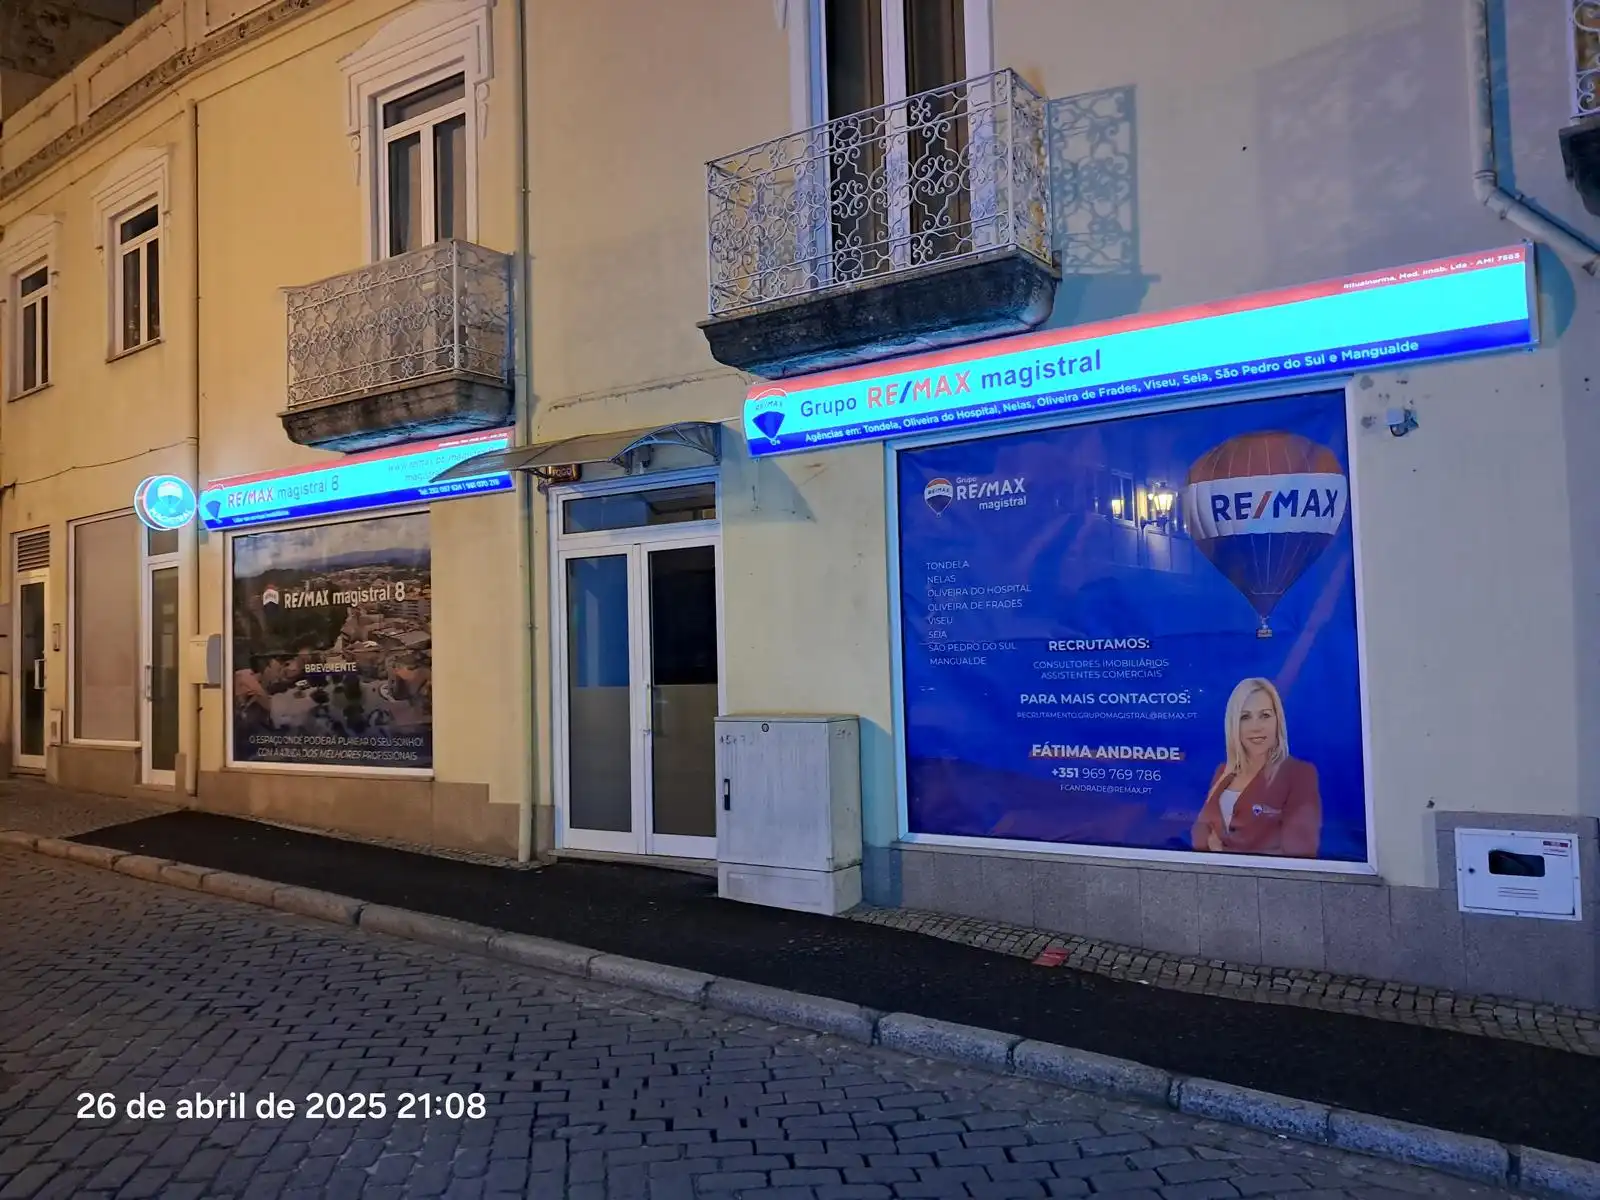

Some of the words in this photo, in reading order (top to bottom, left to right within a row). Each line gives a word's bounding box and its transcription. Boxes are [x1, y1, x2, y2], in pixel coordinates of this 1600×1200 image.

[1475, 257, 1494, 266] AMI
[800, 397, 857, 417] Grupo
[867, 370, 971, 409] RE/MAX
[981, 349, 1101, 389] magistral
[805, 428, 843, 443] Agências
[845, 427, 862, 436] em:
[863, 420, 902, 434] Tondela,
[903, 415, 940, 427] Oliveira
[941, 412, 955, 422] do
[956, 407, 1001, 420] Hospital,
[1003, 401, 1035, 413] Nelas,
[1037, 392, 1079, 407] Oliveira
[1082, 389, 1096, 401] de
[1098, 383, 1142, 398] Frades,
[1144, 377, 1180, 391] Viseu,
[1182, 371, 1212, 385] Seia,
[1215, 367, 1239, 380] São
[1242, 361, 1280, 376] Pedro
[1283, 358, 1300, 370] do
[1304, 354, 1326, 367] Sul
[1329, 354, 1338, 363] e
[1341, 340, 1419, 361] Mangualde
[956, 476, 977, 485] Grupo
[227, 486, 273, 509] RE/MAX
[277, 480, 327, 500] magistral
[331, 474, 339, 492] 8
[956, 478, 1026, 501] RE/MAX
[979, 496, 1027, 511] magistral
[1211, 489, 1338, 522] RE/MAX
[926, 560, 970, 571] TONDELA
[928, 575, 956, 585] NELAS
[284, 588, 329, 609] RE/MAX
[332, 584, 390, 607] magistral
[395, 581, 406, 602] 8
[928, 589, 968, 598] OLIVEIRA
[971, 588, 986, 596] DO
[988, 584, 1032, 595] HOSPITAL
[928, 602, 968, 612] OLIVEIRA
[971, 602, 984, 611] DE
[986, 599, 1023, 609] FRADES
[928, 616, 953, 625] VISEU
[948, 643, 980, 652] PEDRO
[983, 643, 997, 651] DO
[999, 641, 1017, 651] SUL
[1049, 637, 1151, 652] RECRUTAMOS:
[304, 662, 357, 673] BREVEMENTE
[930, 657, 987, 666] MANGUALDE
[1033, 660, 1100, 669] CONSULTORES
[1103, 657, 1170, 668] IMOBILIÁRIOS
[1041, 671, 1100, 680] ASSISTENTES
[1102, 669, 1163, 679] COMERCIAIS
[1020, 693, 1057, 705] PARA
[1061, 693, 1095, 704] MAIS
[1098, 692, 1191, 705] CONTACTOS:
[1032, 741, 1093, 757] FÁTIMA
[1095, 746, 1181, 760] ANDRADE
[1052, 767, 1079, 779] +351
[1082, 767, 1106, 779] 969
[1110, 768, 1133, 781] 769
[1136, 769, 1162, 782] 786
